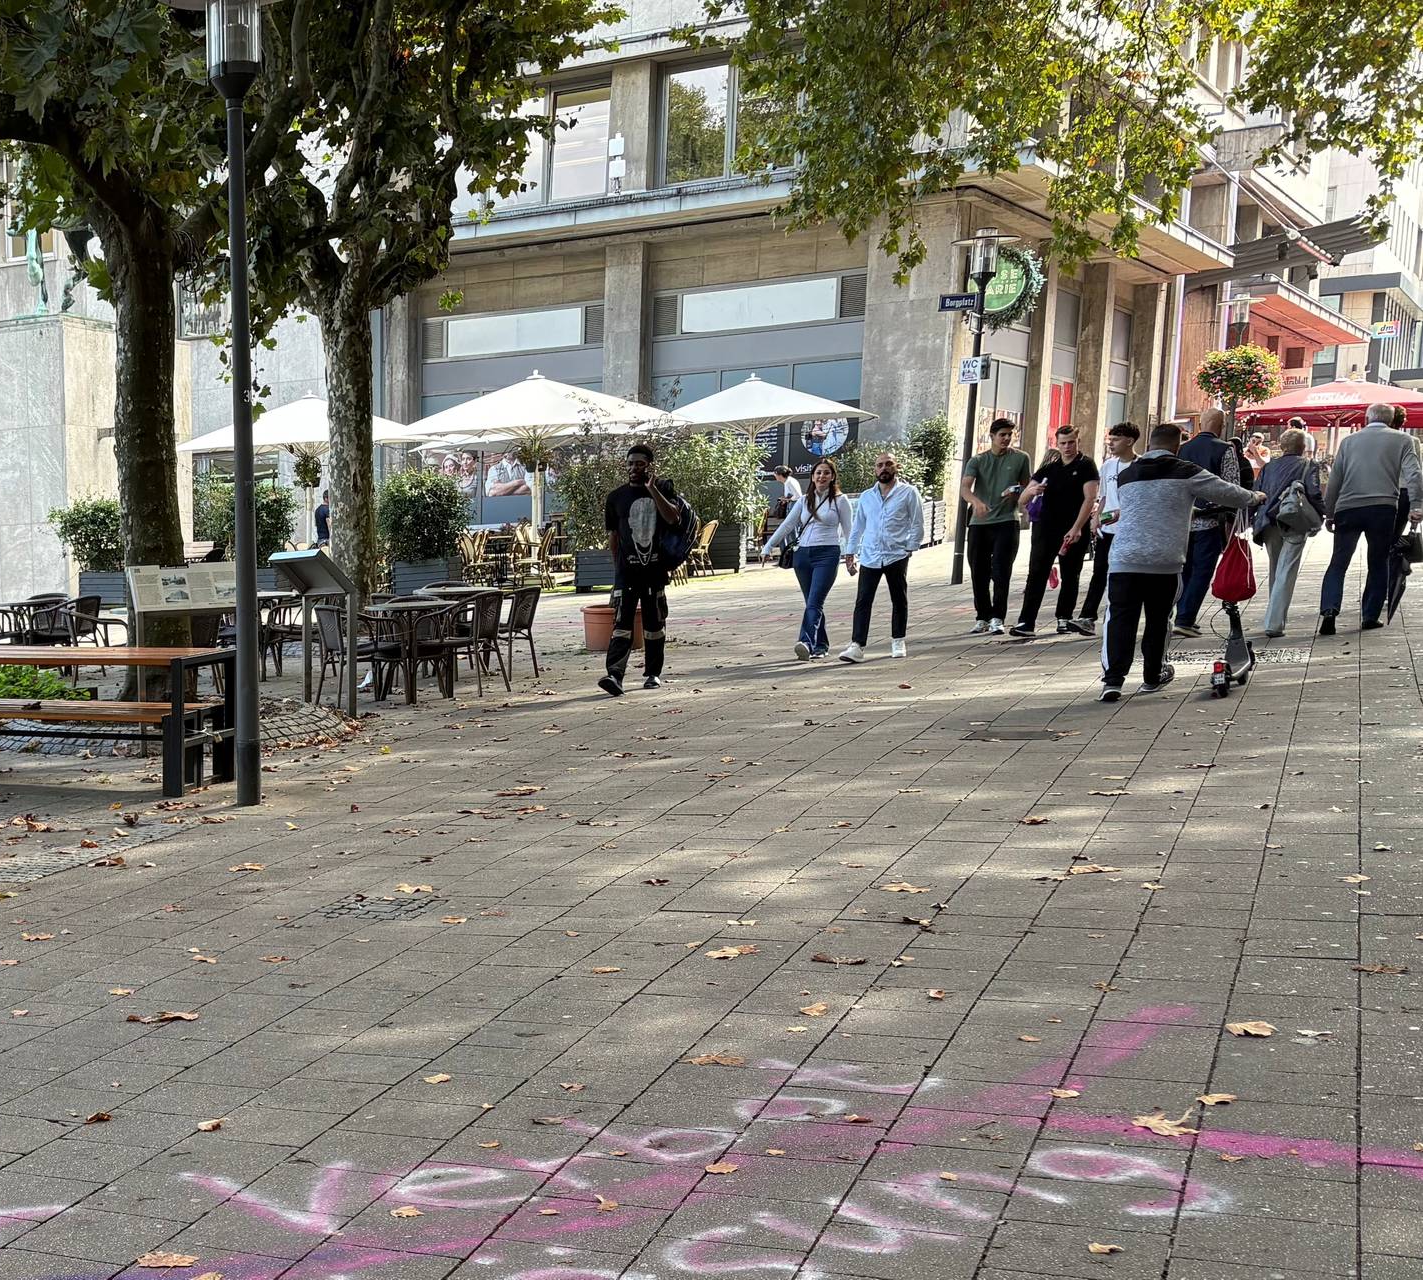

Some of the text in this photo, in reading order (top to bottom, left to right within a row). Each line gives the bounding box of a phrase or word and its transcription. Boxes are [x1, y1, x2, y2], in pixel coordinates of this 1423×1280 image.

[985, 283, 1017, 295] ARIE
[1380, 324, 1394, 332] dm
[962, 359, 979, 369] WC
[177, 1055, 943, 1238] Verbot
